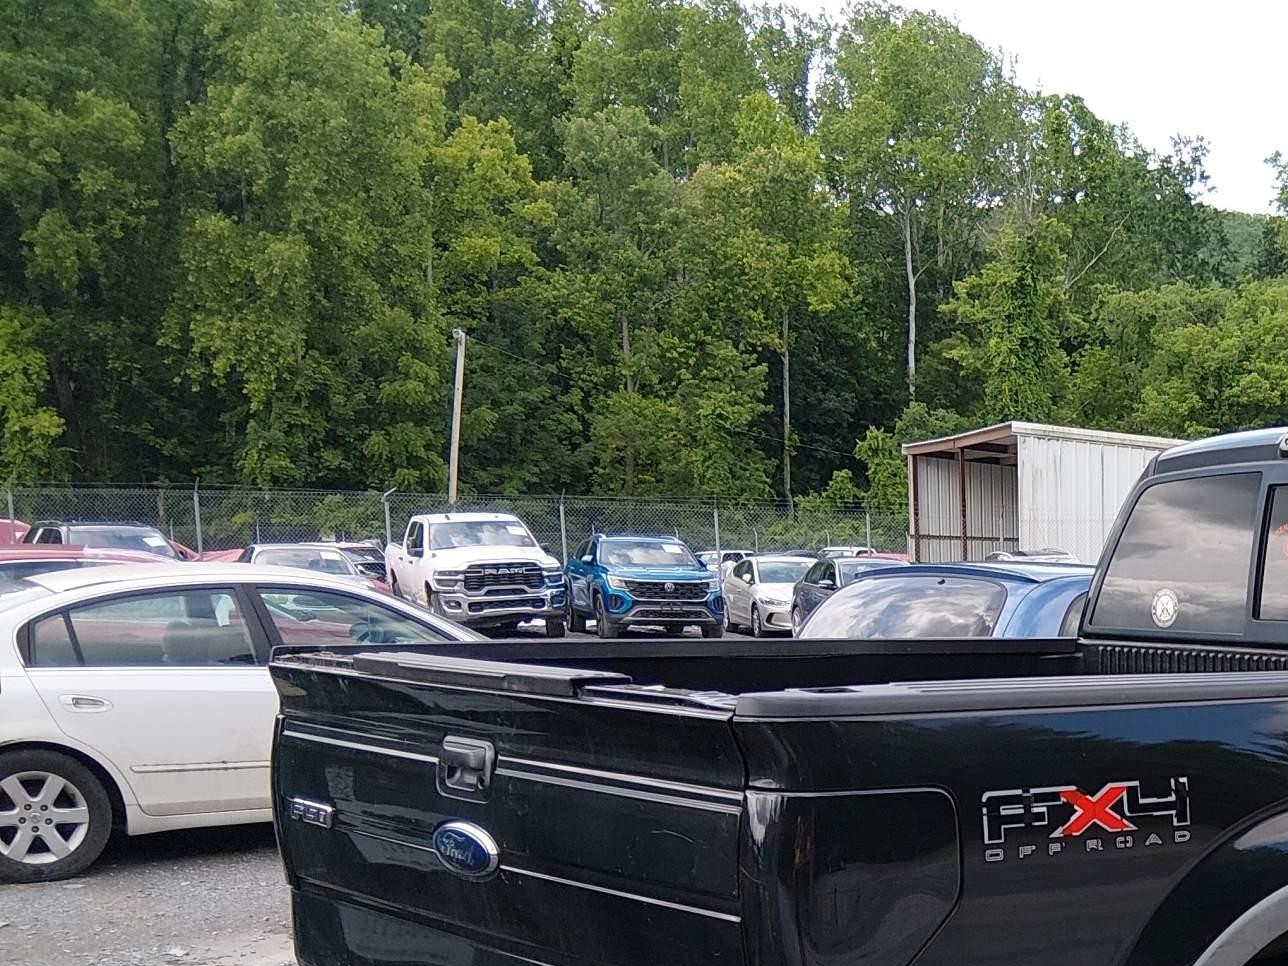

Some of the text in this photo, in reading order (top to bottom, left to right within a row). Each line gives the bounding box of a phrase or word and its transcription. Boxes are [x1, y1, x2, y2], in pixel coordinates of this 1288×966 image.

[484, 567, 523, 575] RAM
[981, 776, 1191, 844] FX4
[437, 831, 475, 867] Ford
[1085, 829, 1191, 852] ROAD
